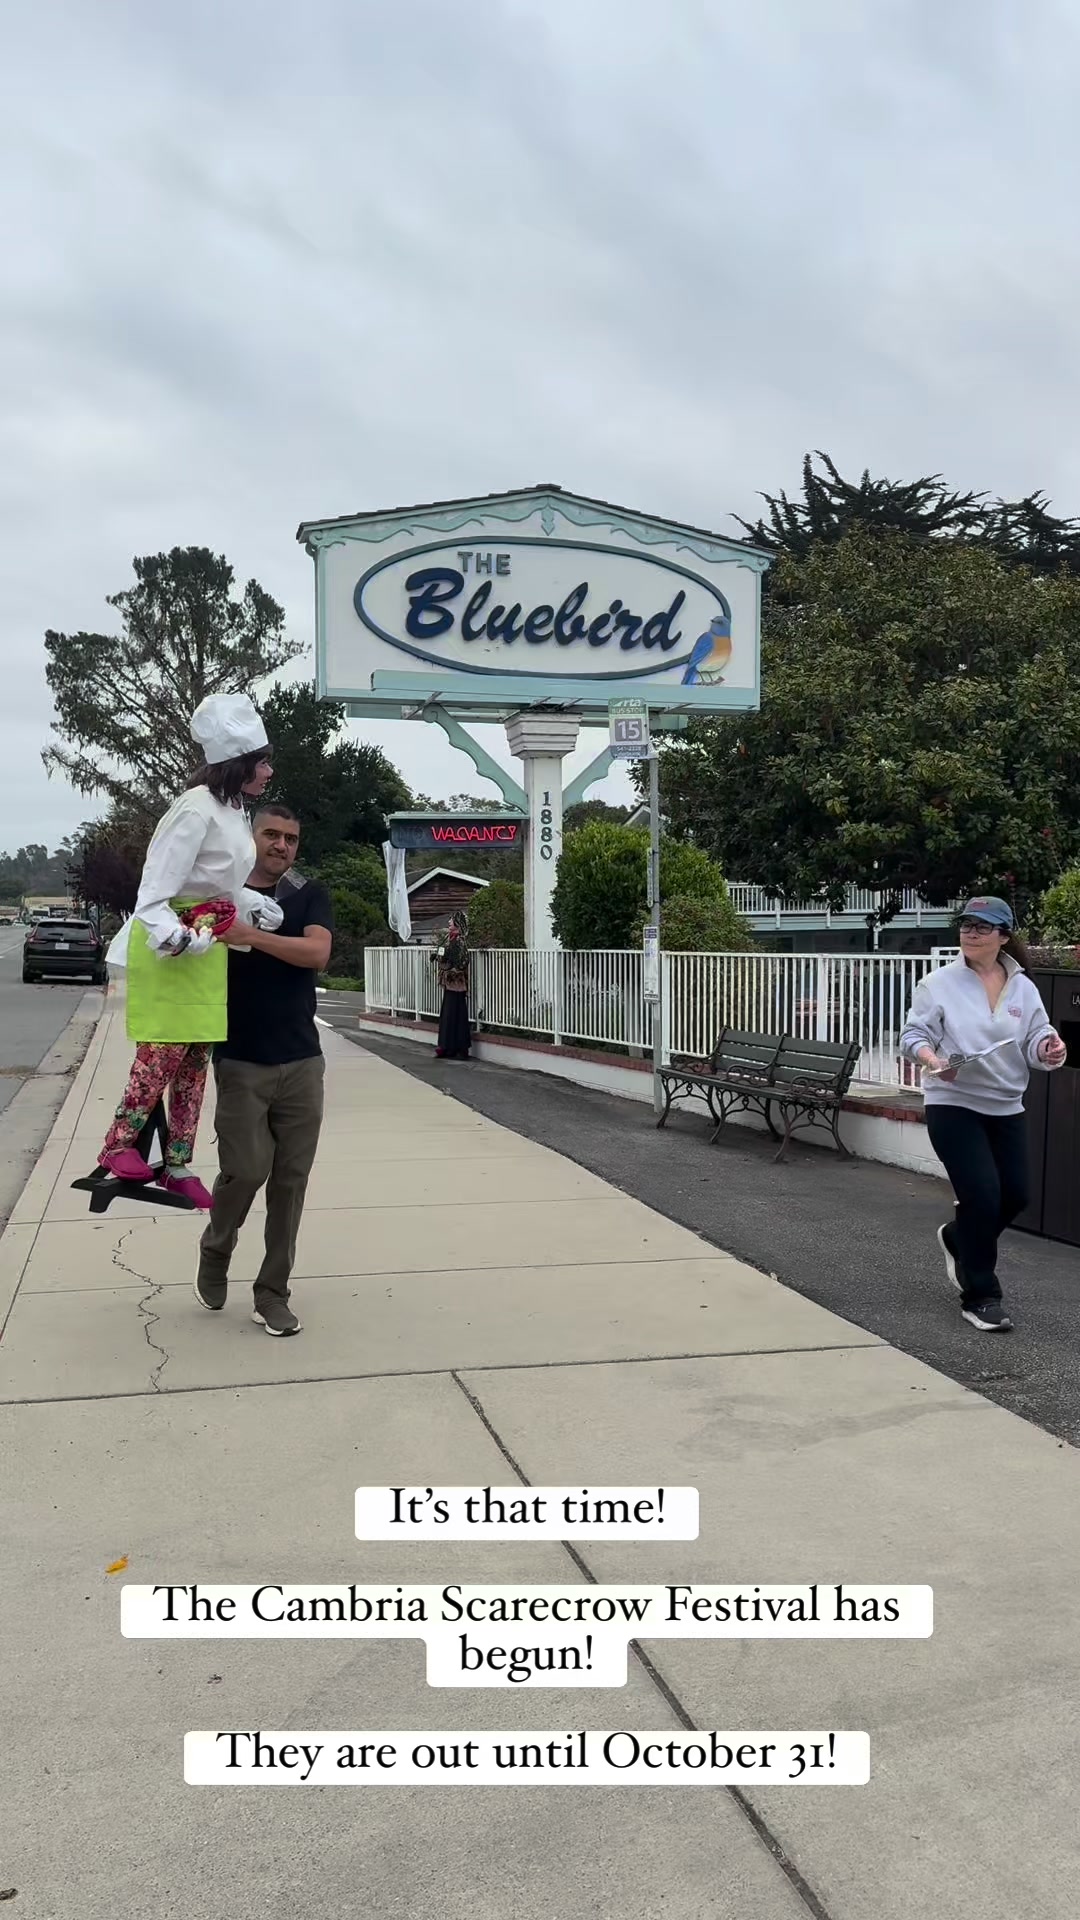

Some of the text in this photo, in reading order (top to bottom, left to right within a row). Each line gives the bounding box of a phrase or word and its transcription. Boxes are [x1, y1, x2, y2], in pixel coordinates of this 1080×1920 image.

[457, 551, 511, 576] THE
[405, 567, 686, 651] Bluebird
[617, 721, 640, 739] 15
[431, 825, 517, 841] VACANCY
[540, 791, 553, 861] 1880
